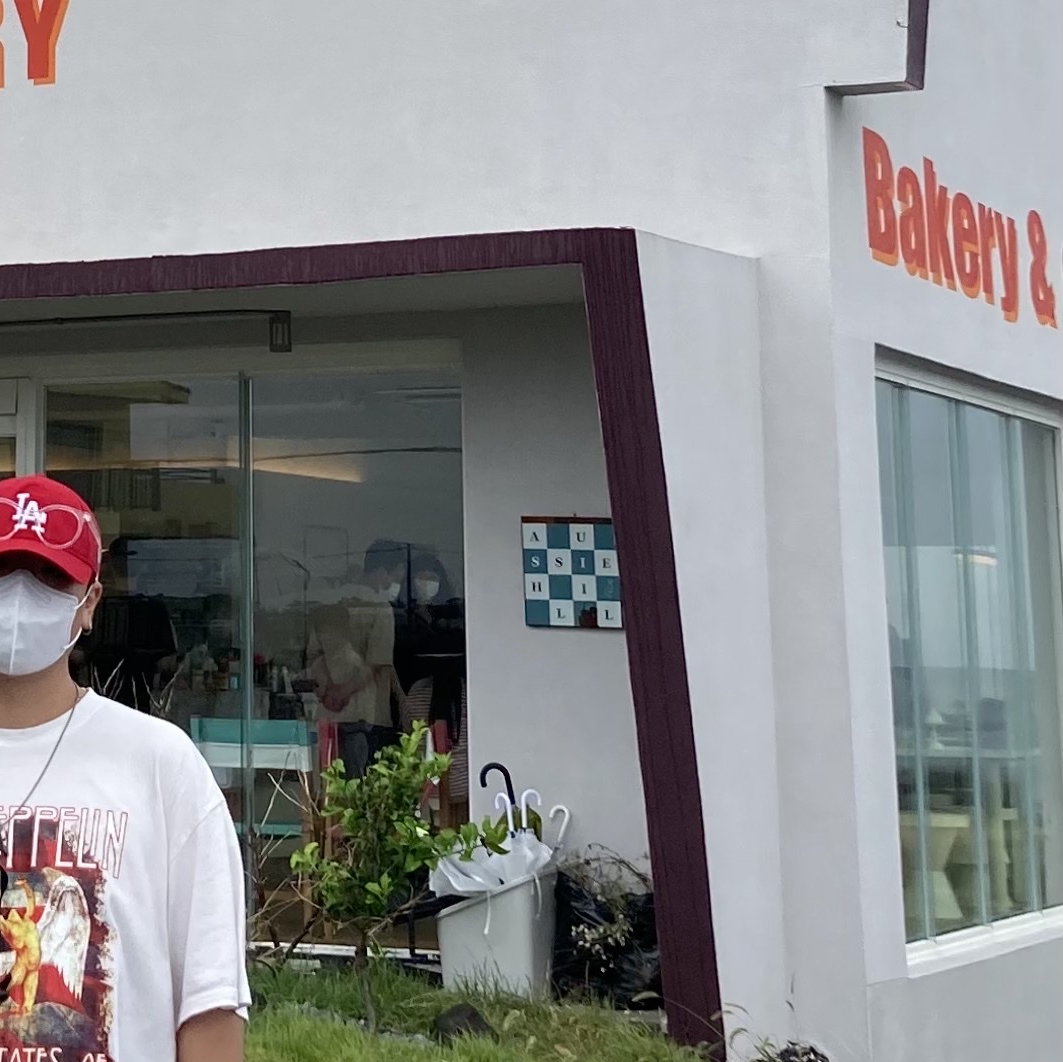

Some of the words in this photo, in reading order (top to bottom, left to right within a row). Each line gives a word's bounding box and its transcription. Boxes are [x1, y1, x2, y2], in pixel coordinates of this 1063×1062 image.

[862, 126, 1018, 323] Bakery
[1027, 209, 1058, 329] &
[12, 492, 47, 534] LA
